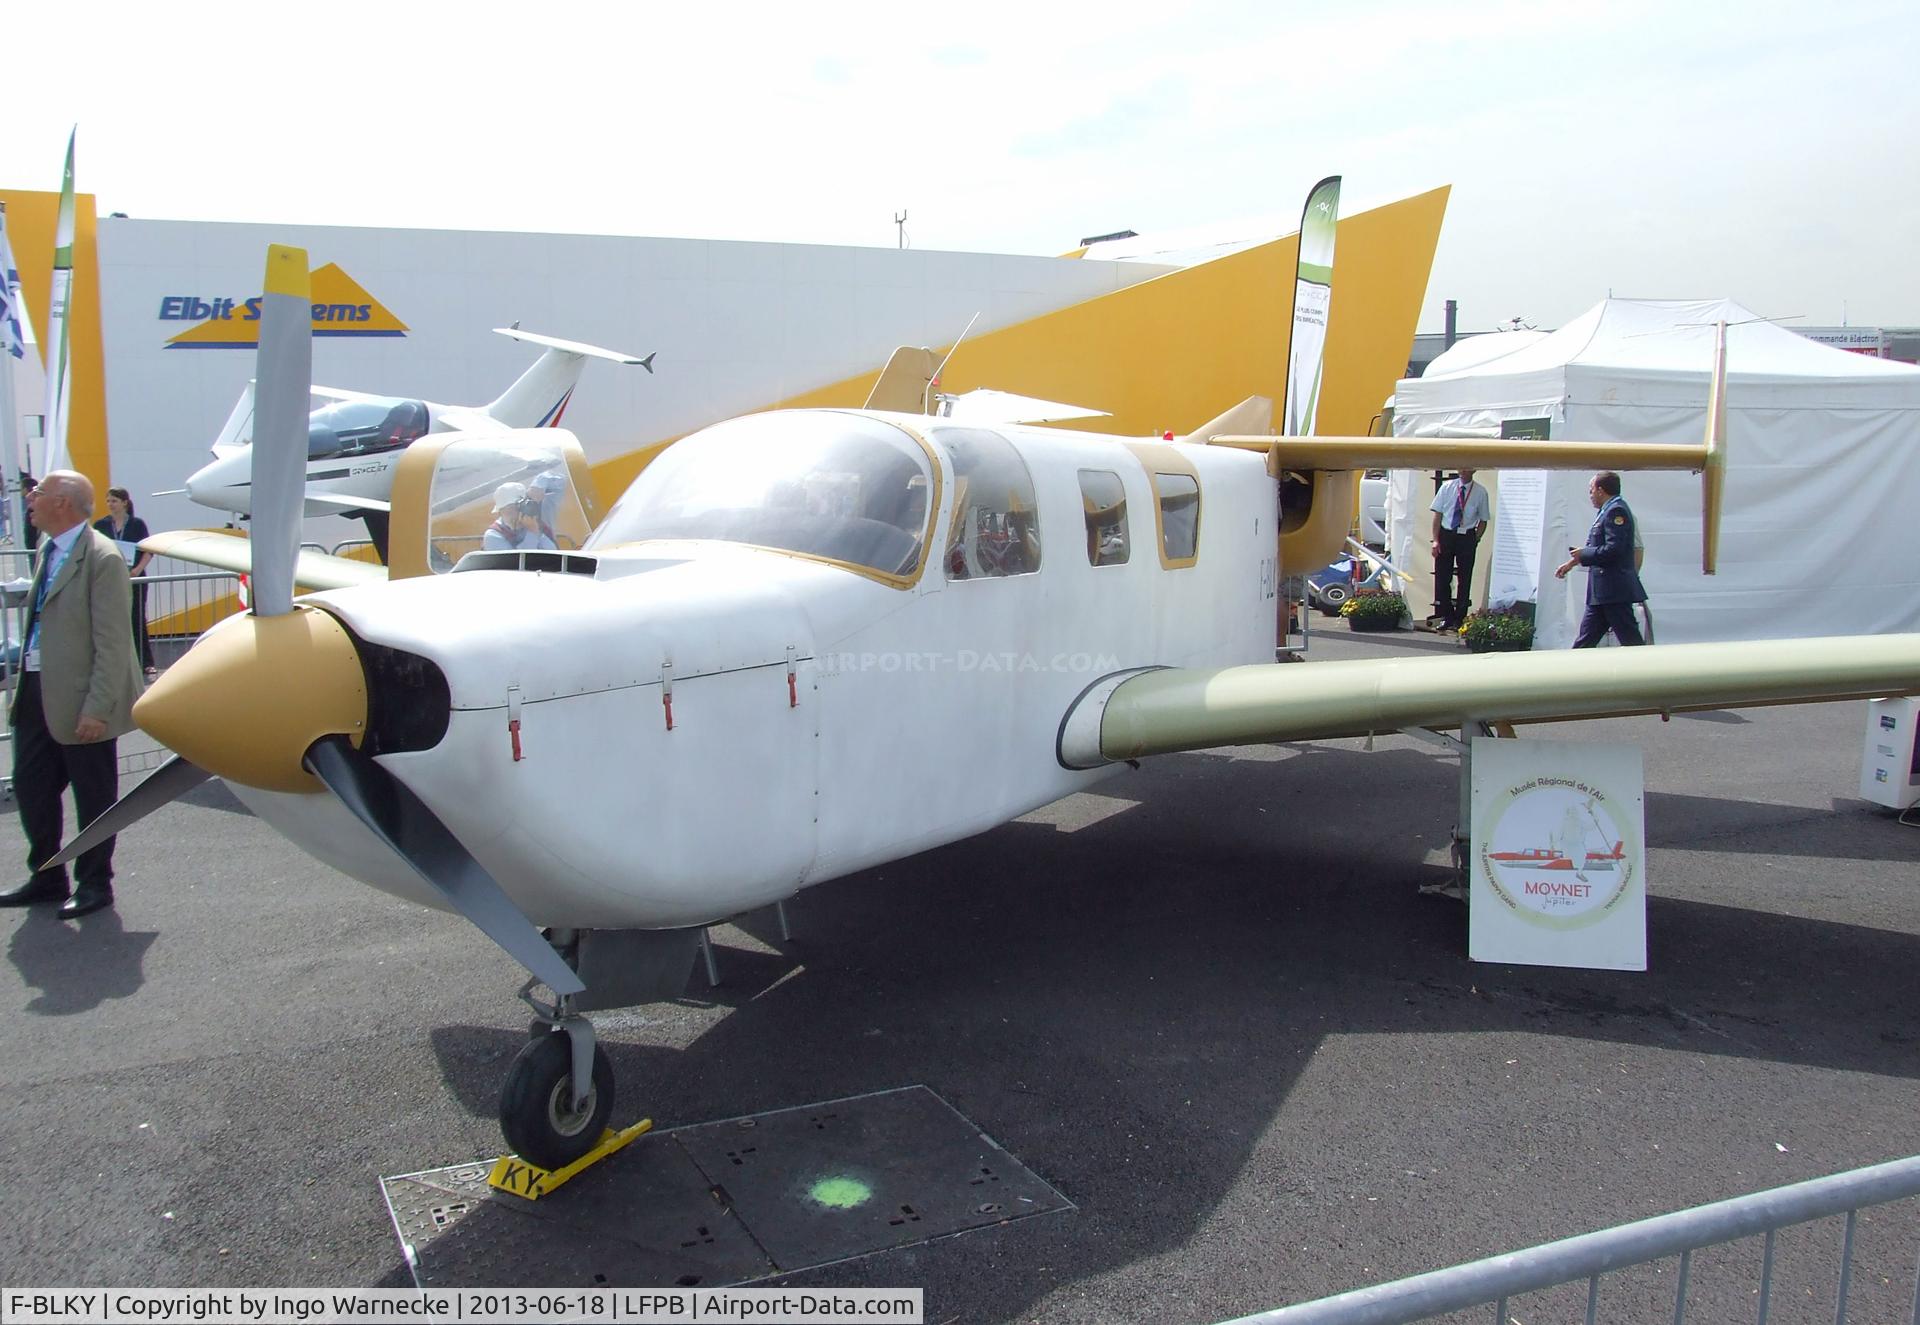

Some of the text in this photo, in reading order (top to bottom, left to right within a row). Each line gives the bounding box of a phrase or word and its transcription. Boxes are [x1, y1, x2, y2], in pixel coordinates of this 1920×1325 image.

[159, 296, 372, 322] Elbit Sems
[1510, 777, 1605, 802] Musée Régional de l'Air
[1525, 881, 1592, 898] MOYNET
[501, 1162, 544, 1195] KY
